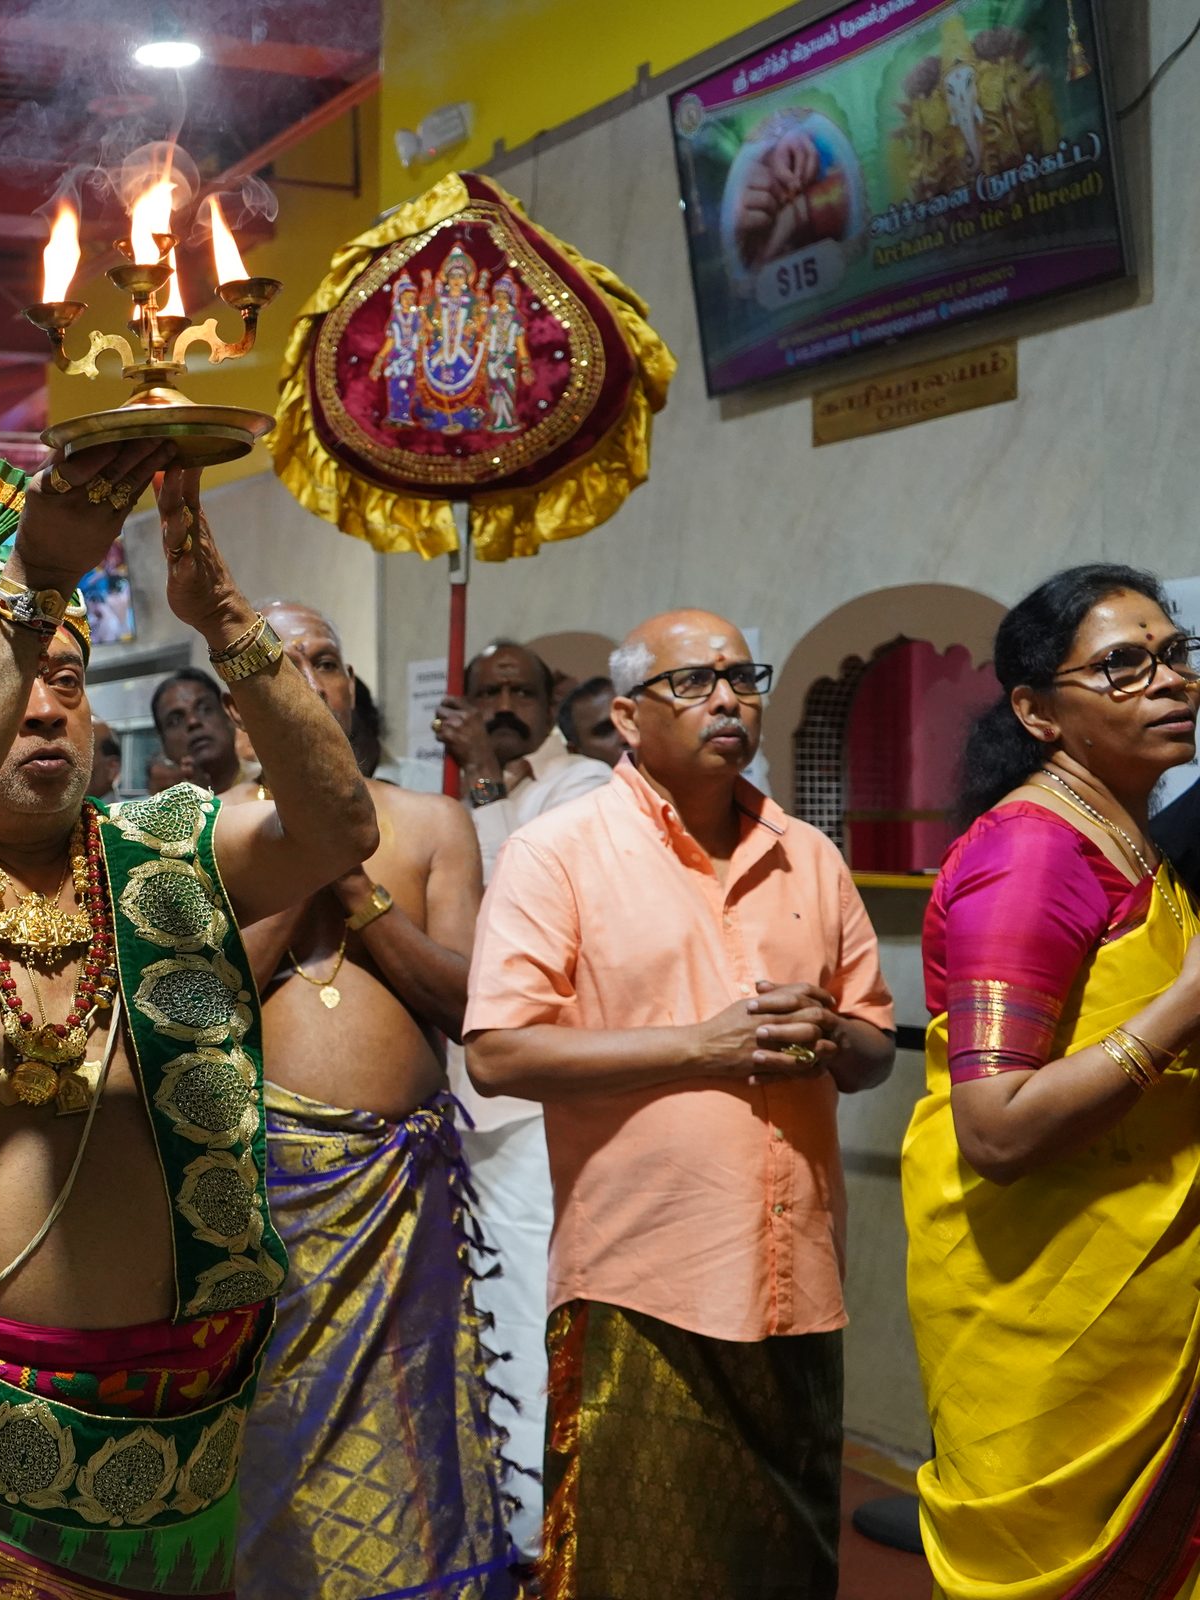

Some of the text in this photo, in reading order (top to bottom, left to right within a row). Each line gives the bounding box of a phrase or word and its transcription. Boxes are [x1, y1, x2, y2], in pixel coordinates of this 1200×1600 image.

[874, 171, 1103, 267] Archana (to tie a thread)
[777, 258, 818, 296] $15
[877, 396, 946, 422] Office
